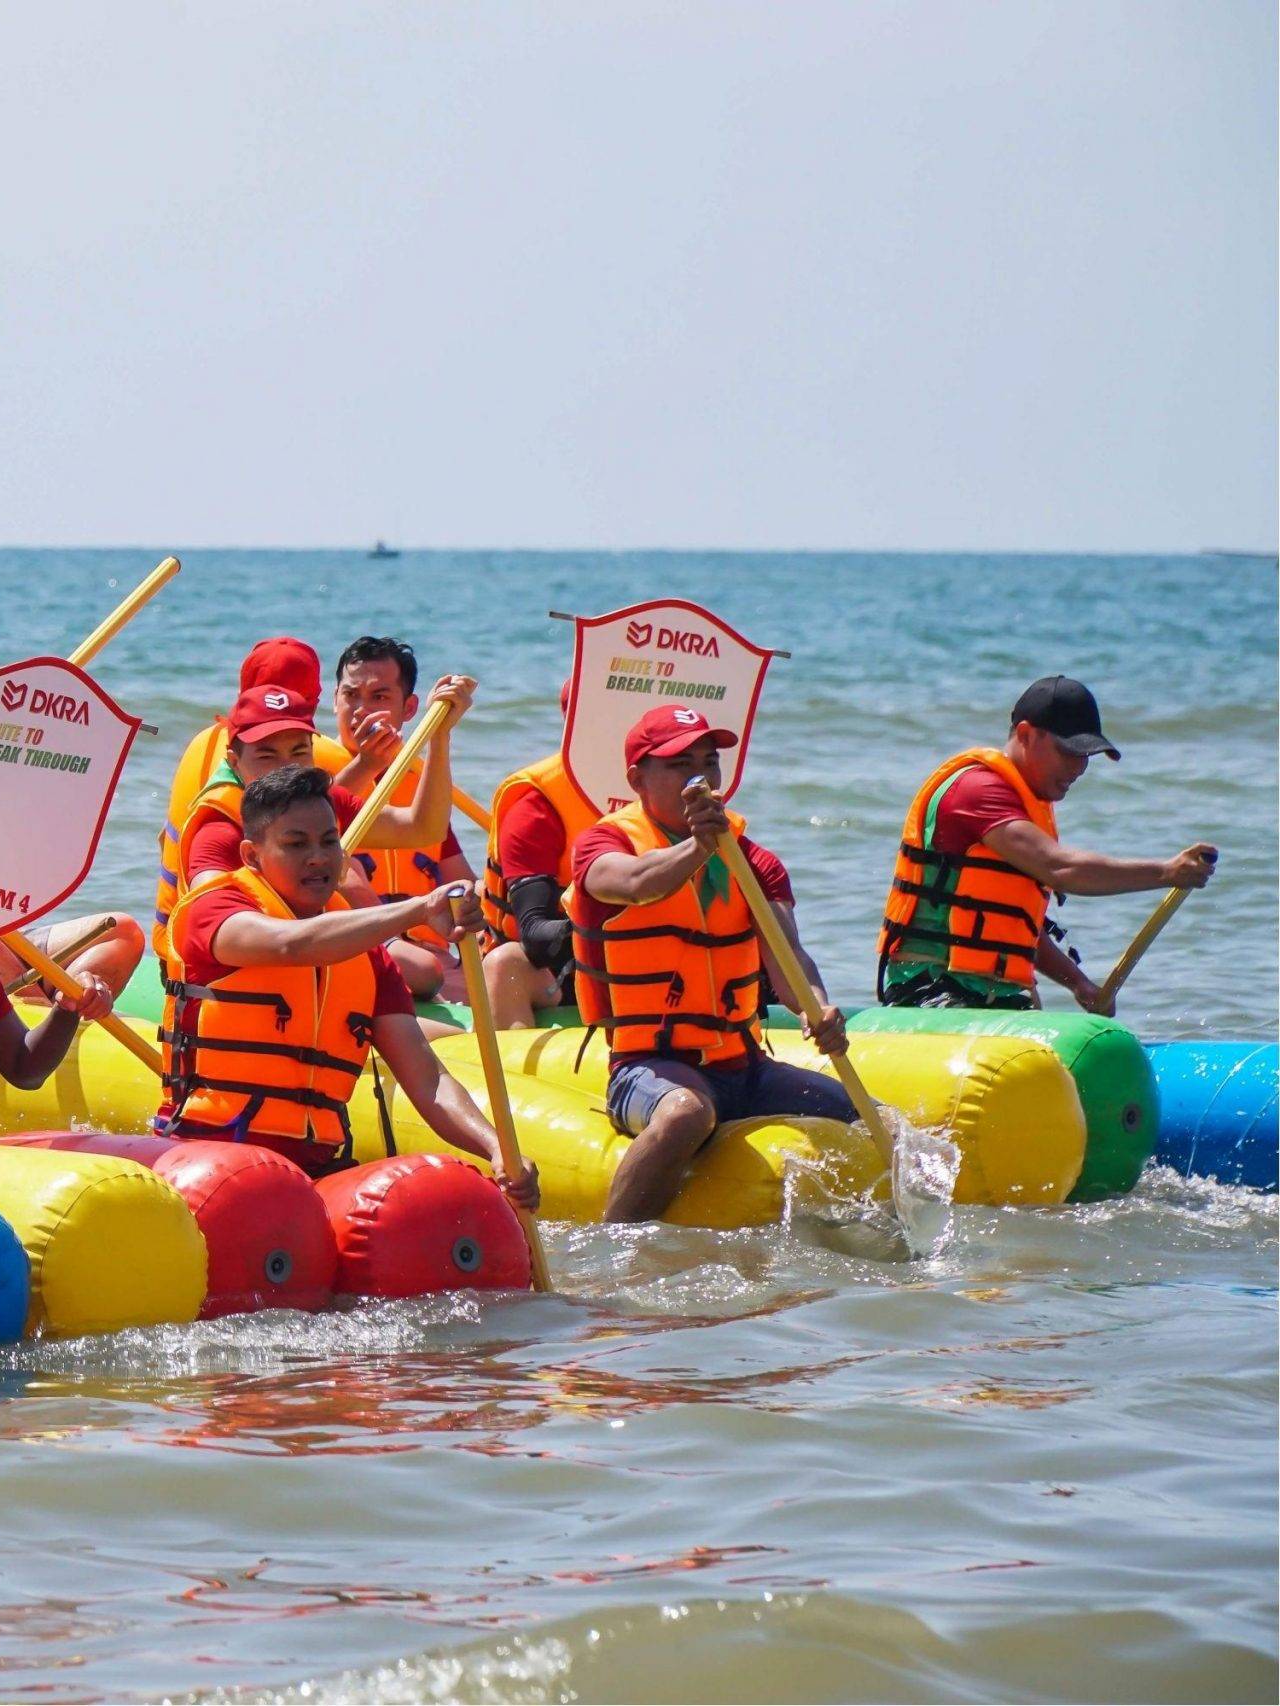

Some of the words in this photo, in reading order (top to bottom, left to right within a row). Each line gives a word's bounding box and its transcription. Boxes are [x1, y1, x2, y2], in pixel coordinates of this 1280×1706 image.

[657, 629, 719, 658] DKRA
[609, 656, 653, 674] UNITE
[656, 661, 675, 677] TO
[606, 675, 654, 694] BREAK
[658, 680, 726, 700] THROUGH
[29, 689, 90, 726] DKRA
[24, 726, 45, 746] TO
[24, 749, 91, 774] THROUGH
[19, 895, 31, 914] 4
